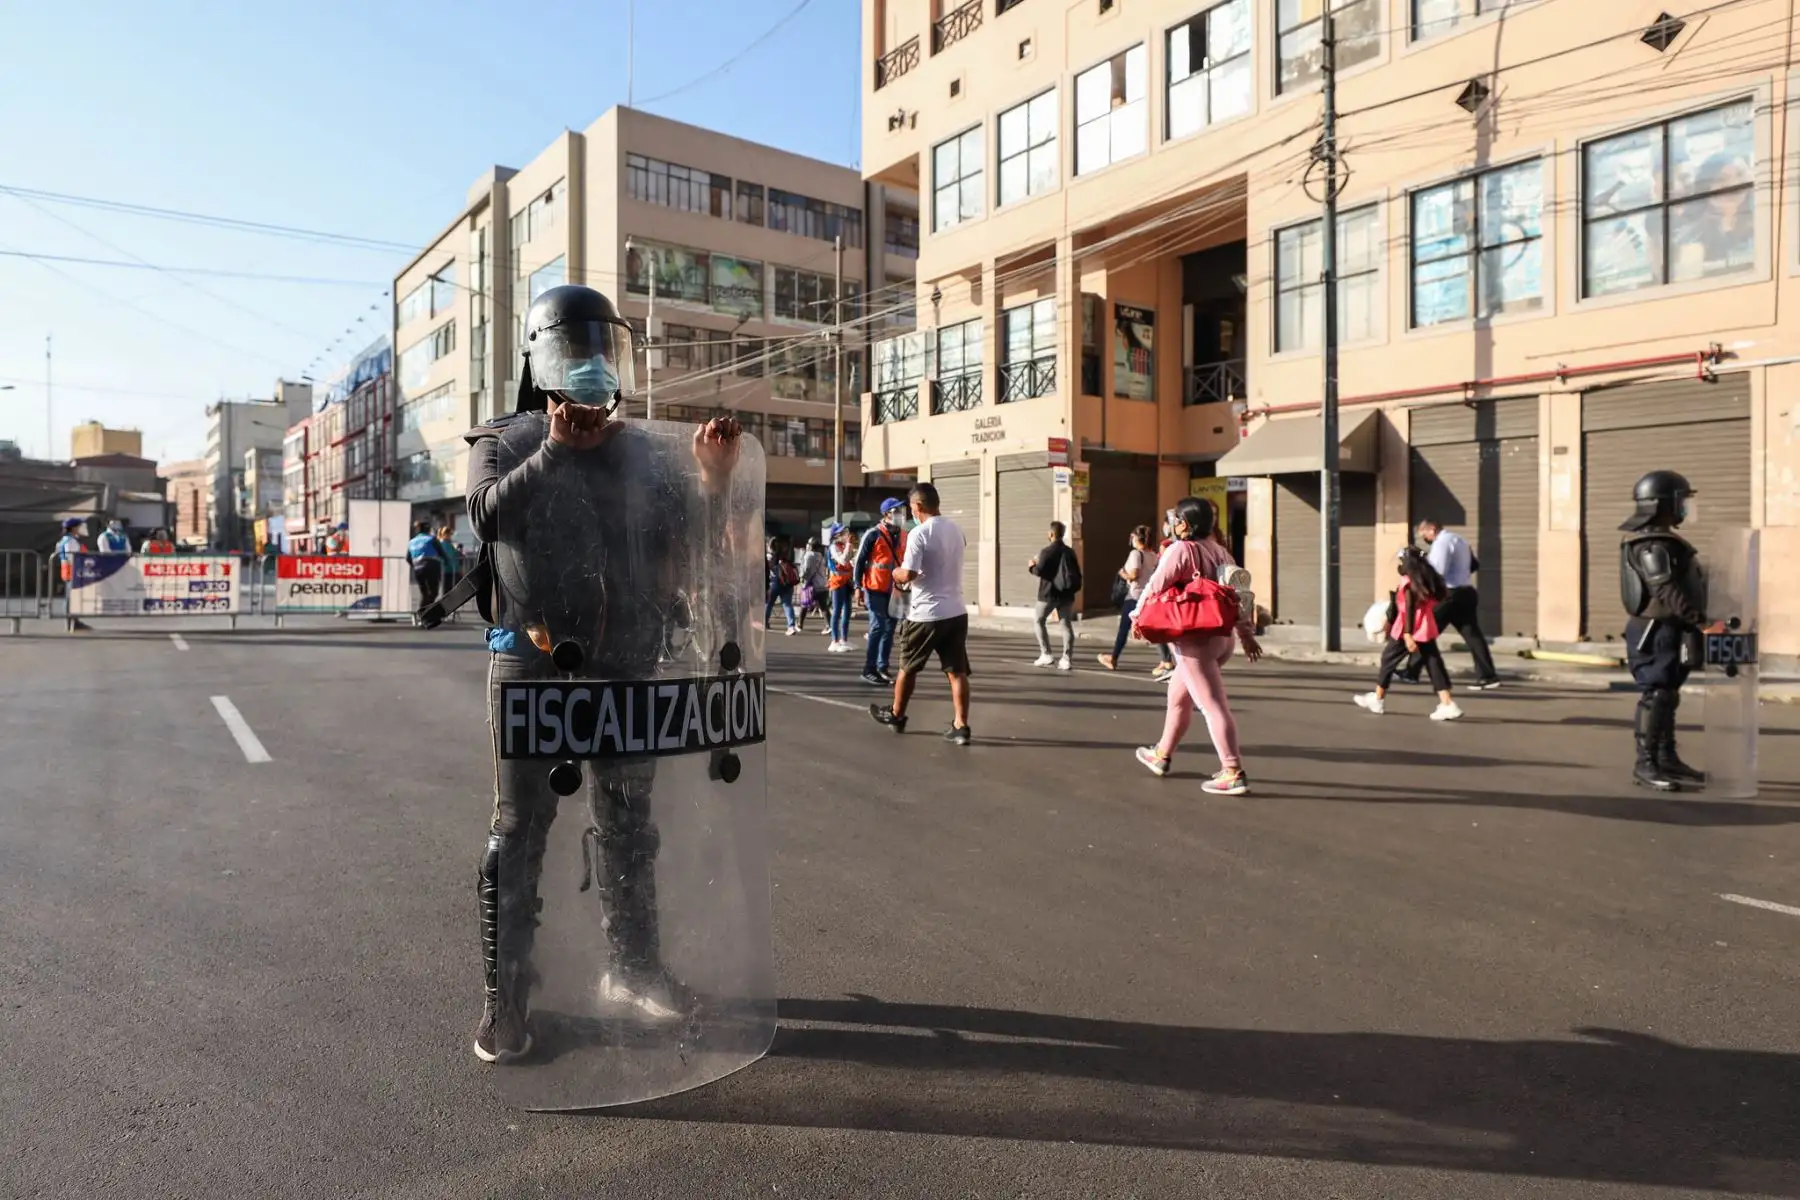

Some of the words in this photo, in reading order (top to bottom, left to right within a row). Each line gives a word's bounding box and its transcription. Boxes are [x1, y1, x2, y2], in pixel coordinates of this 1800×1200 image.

[974, 415, 1002, 429] GALERIA
[971, 430, 1006, 443] TRADICION
[296, 558, 364, 578] Ingreso
[290, 580, 368, 597] peatonal
[505, 673, 765, 754] FISCALIZACIÓN
